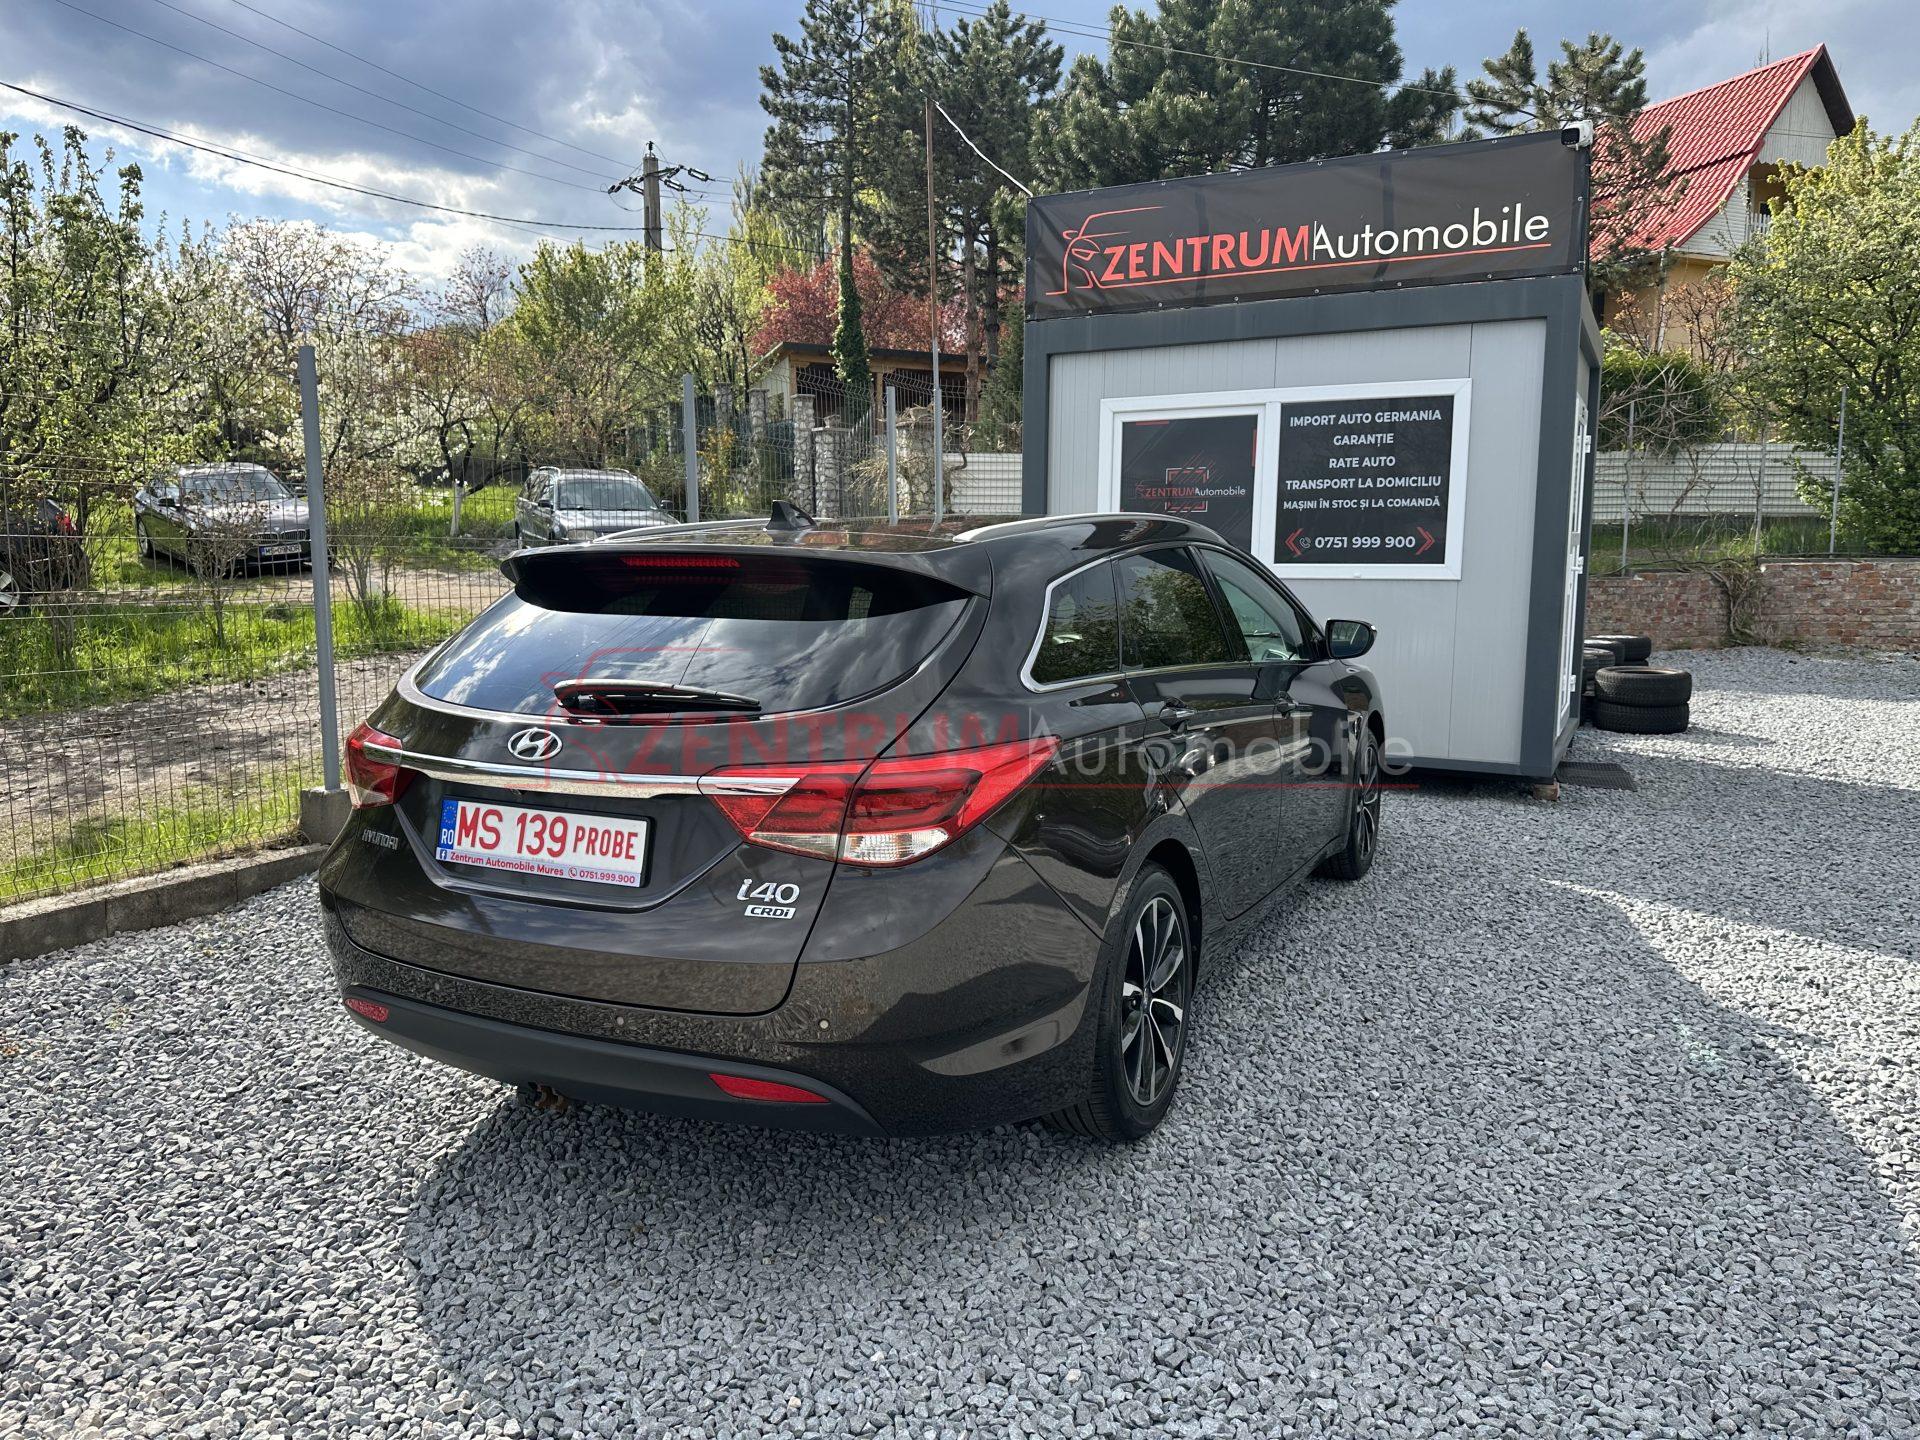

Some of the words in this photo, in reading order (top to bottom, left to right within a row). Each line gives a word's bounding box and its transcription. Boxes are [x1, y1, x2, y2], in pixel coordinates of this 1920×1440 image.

[1101, 225, 1309, 282] ZENTRUM
[1314, 202, 1550, 261] Automobile
[1290, 415, 1336, 427] IMPORT
[1338, 412, 1372, 425] AUTO
[1375, 410, 1442, 422] GERMANIA
[1333, 433, 1394, 447] GARANȚIE
[1329, 457, 1359, 468] RATE
[1361, 456, 1396, 467] AUTO
[1286, 478, 1355, 490] TRANSPORT
[1358, 477, 1373, 488] LA
[1376, 476, 1442, 488] DOMICILIU
[1283, 500, 1317, 511] MAȘINI
[1319, 498, 1330, 509] ÎN
[1332, 499, 1357, 509] STOC
[1360, 499, 1369, 510] ȘI
[1372, 499, 1384, 508] LA
[1387, 496, 1441, 508] COMANDĂ
[1315, 537, 1347, 548] 0751
[1352, 537, 1381, 548] 999
[1385, 536, 1416, 548] 900
[441, 828, 454, 845] RO
[456, 806, 503, 850] MS
[516, 812, 569, 858] 139
[573, 825, 639, 860] PROBE
[450, 851, 484, 865] Zentrum
[485, 857, 535, 872] Automobile
[537, 864, 564, 876] Mures
[579, 870, 636, 884] 0751.999.900
[737, 878, 800, 904] i40
[751, 907, 790, 918] CRDi
